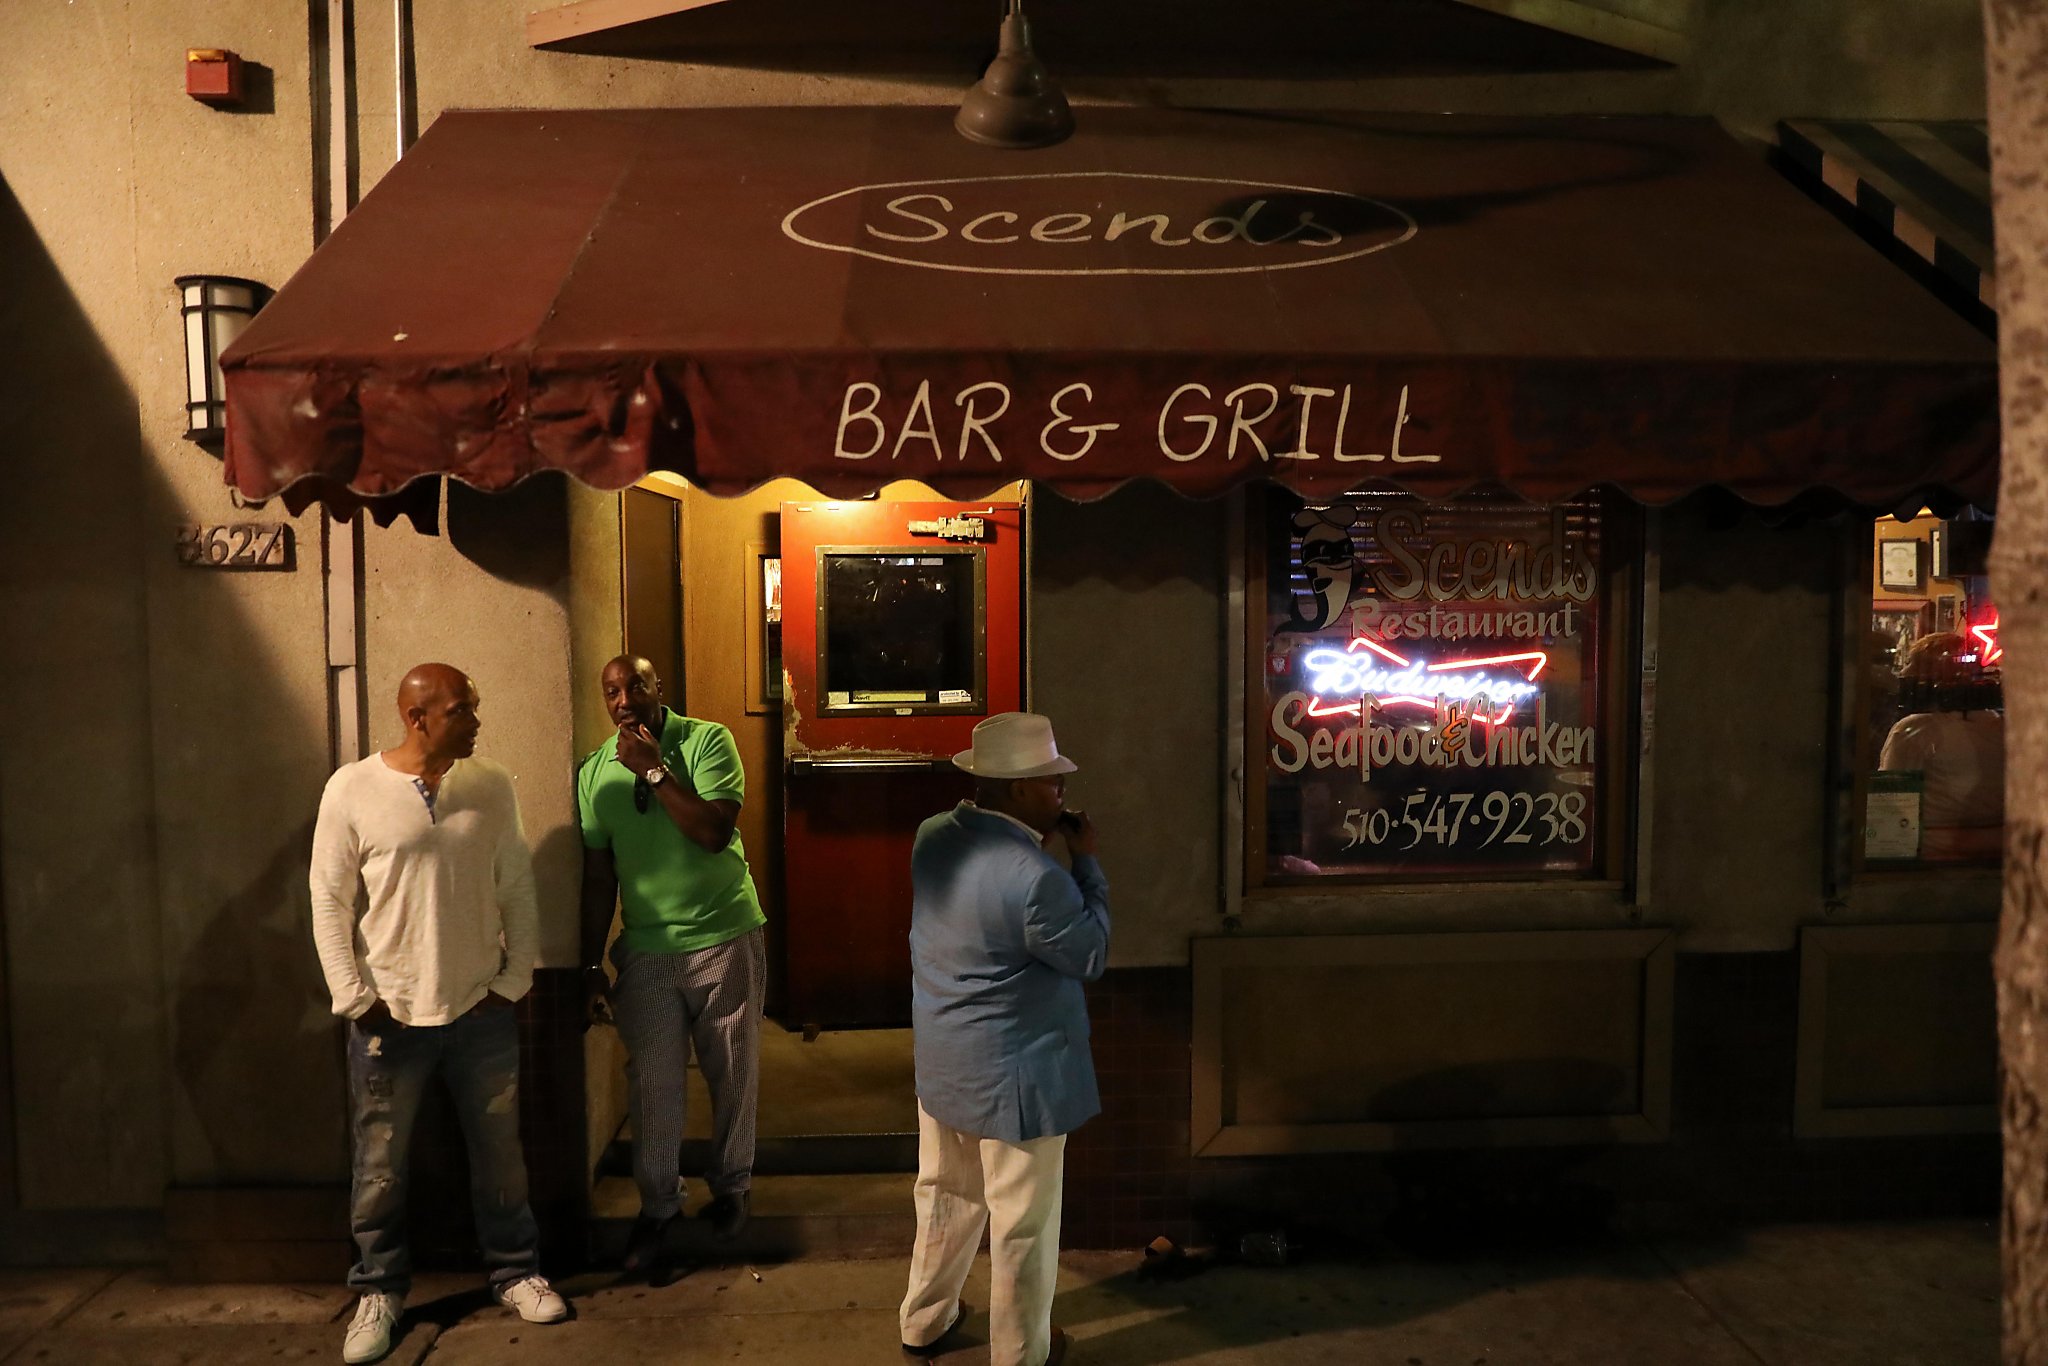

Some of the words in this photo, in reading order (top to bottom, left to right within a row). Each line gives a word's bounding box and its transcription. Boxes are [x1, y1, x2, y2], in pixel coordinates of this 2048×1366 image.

[865, 193, 1343, 247] Scends
[833, 379, 1011, 463] BAR
[1039, 381, 1119, 462] &
[1157, 382, 1442, 463] GRILL
[1372, 506, 1597, 602] Scends
[1350, 599, 1581, 641] Restaurant
[1303, 648, 1538, 702] Budweiser
[1271, 690, 1445, 782] Seafood
[1463, 690, 1596, 768] Chicken
